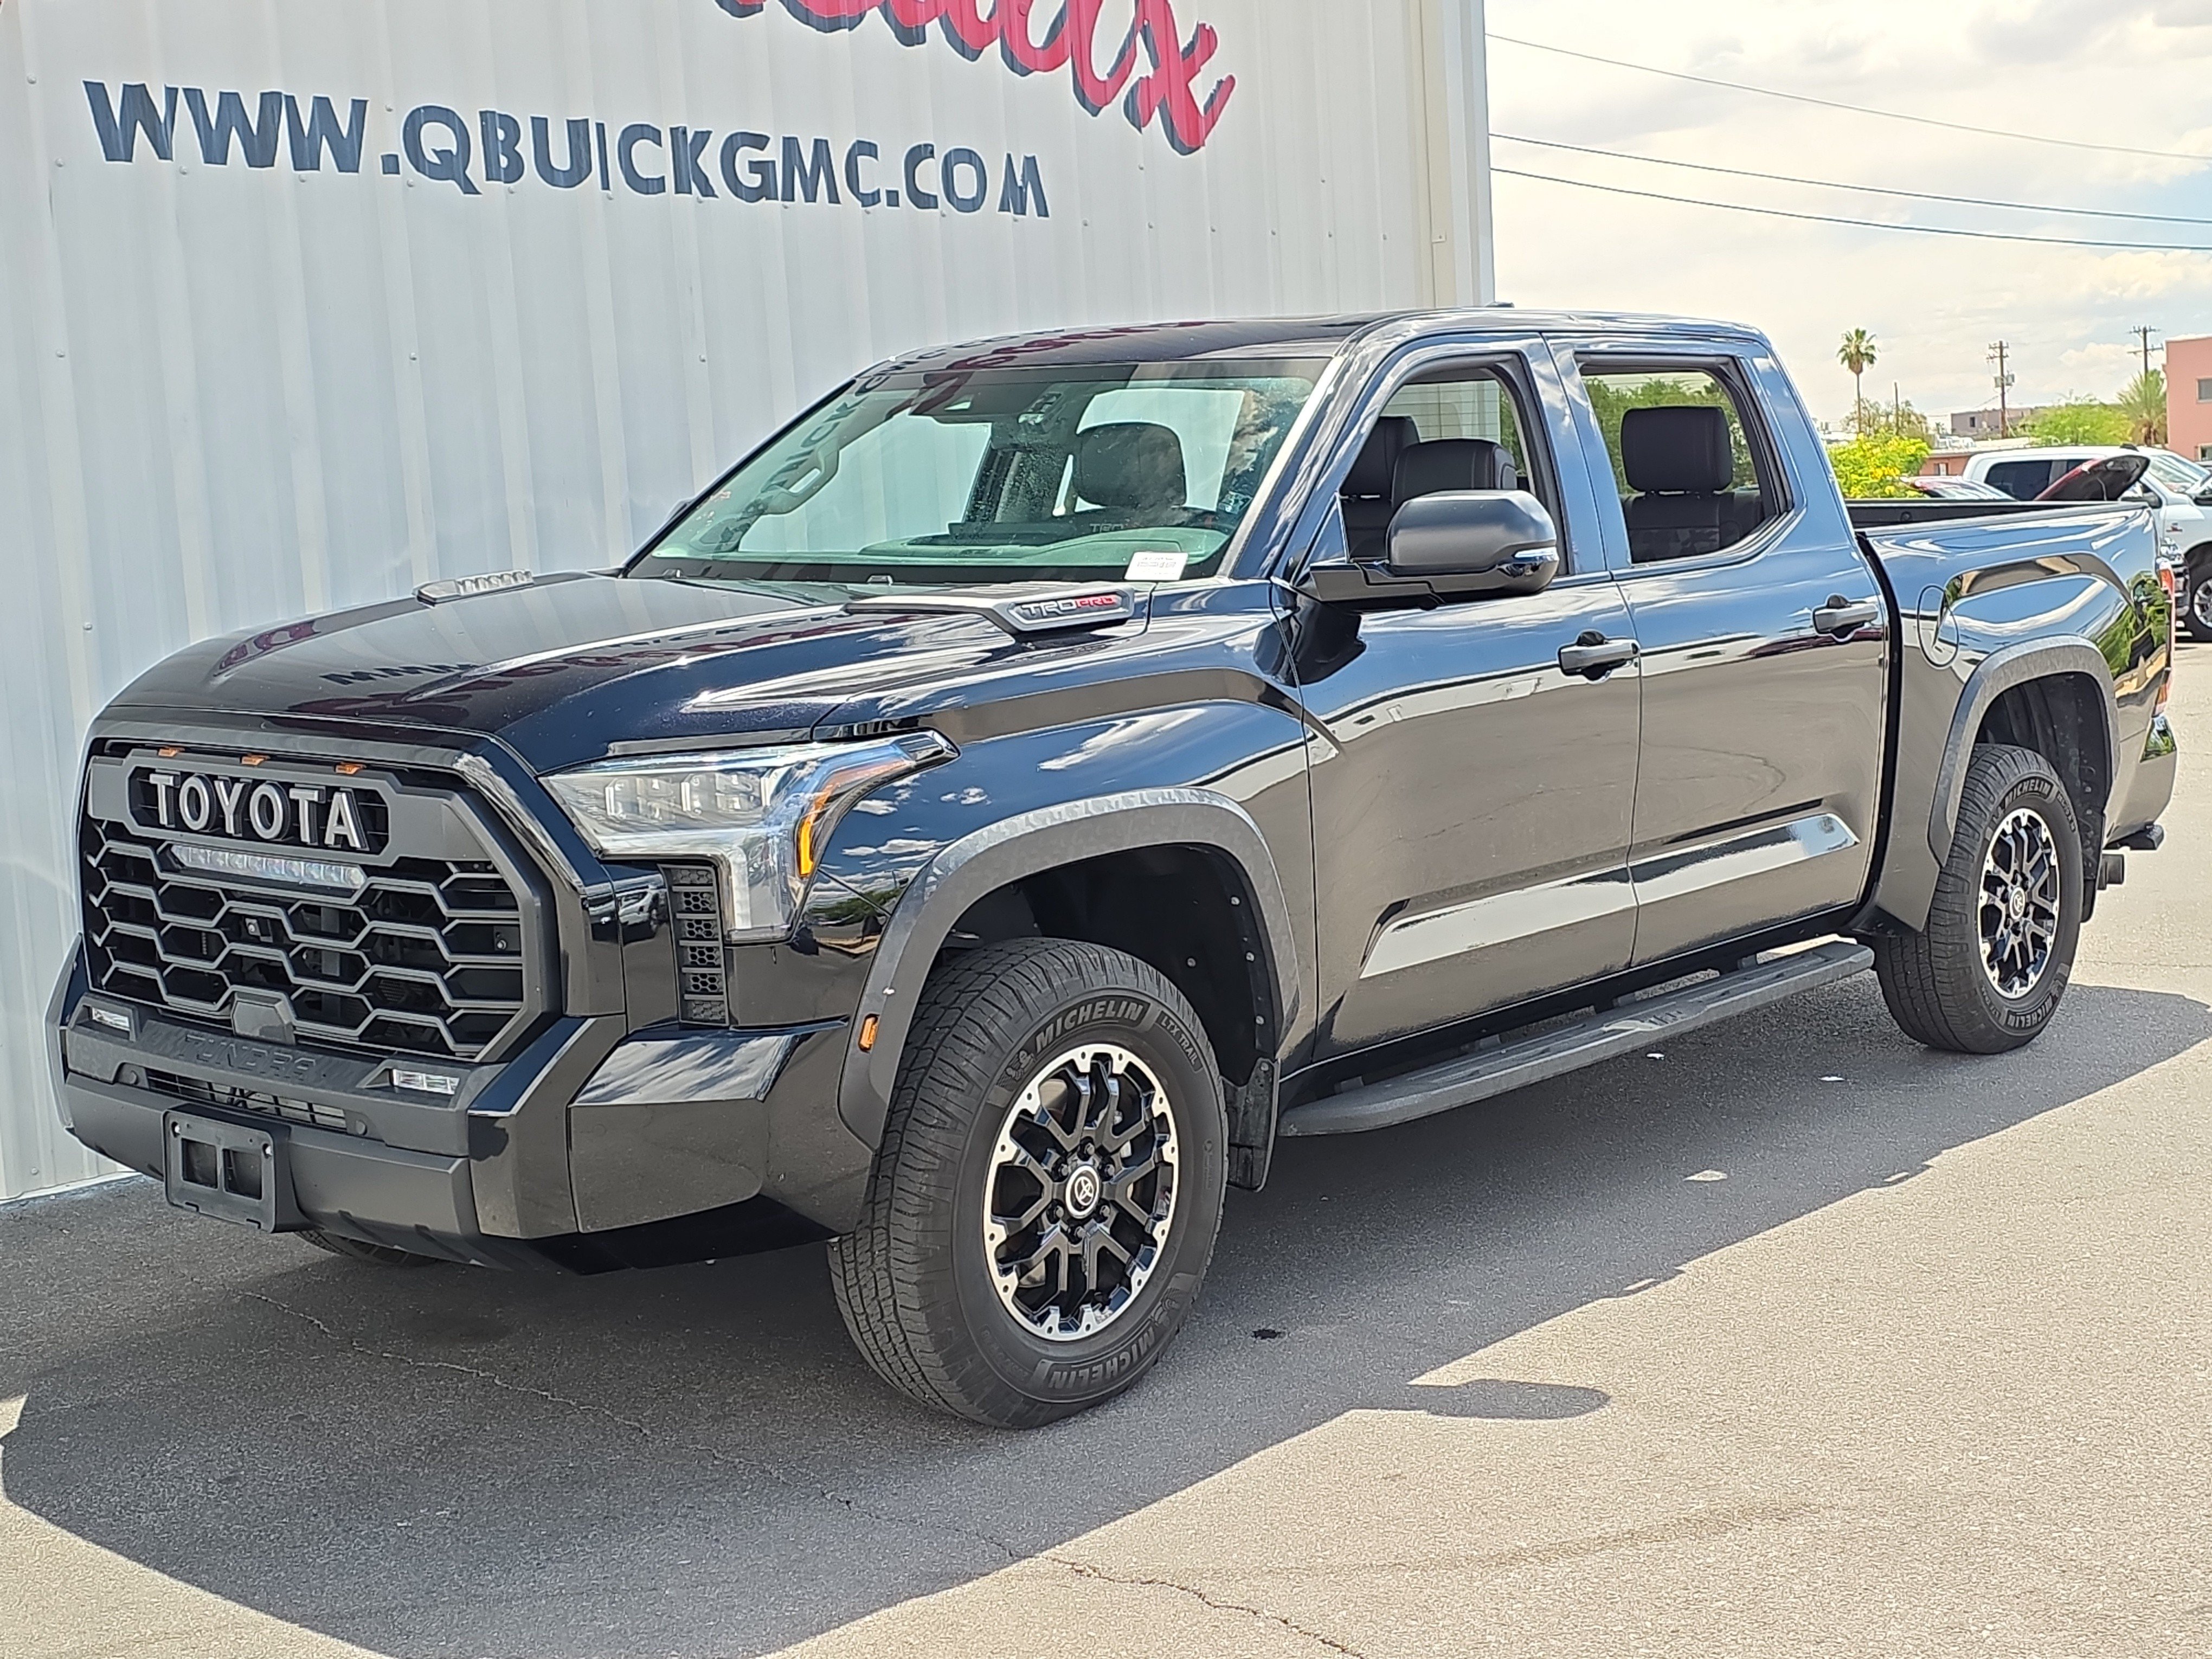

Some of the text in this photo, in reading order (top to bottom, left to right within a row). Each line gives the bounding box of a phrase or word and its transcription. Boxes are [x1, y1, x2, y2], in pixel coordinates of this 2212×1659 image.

[82, 80, 1050, 218] WWW.QBUICKGMC.COM
[149, 768, 370, 851] TOYOTA
[1034, 1000, 1143, 1053] MICHELIN
[1160, 1015, 1198, 1065] LTX TRAIL
[1048, 1326, 1156, 1390] MICHELIN
